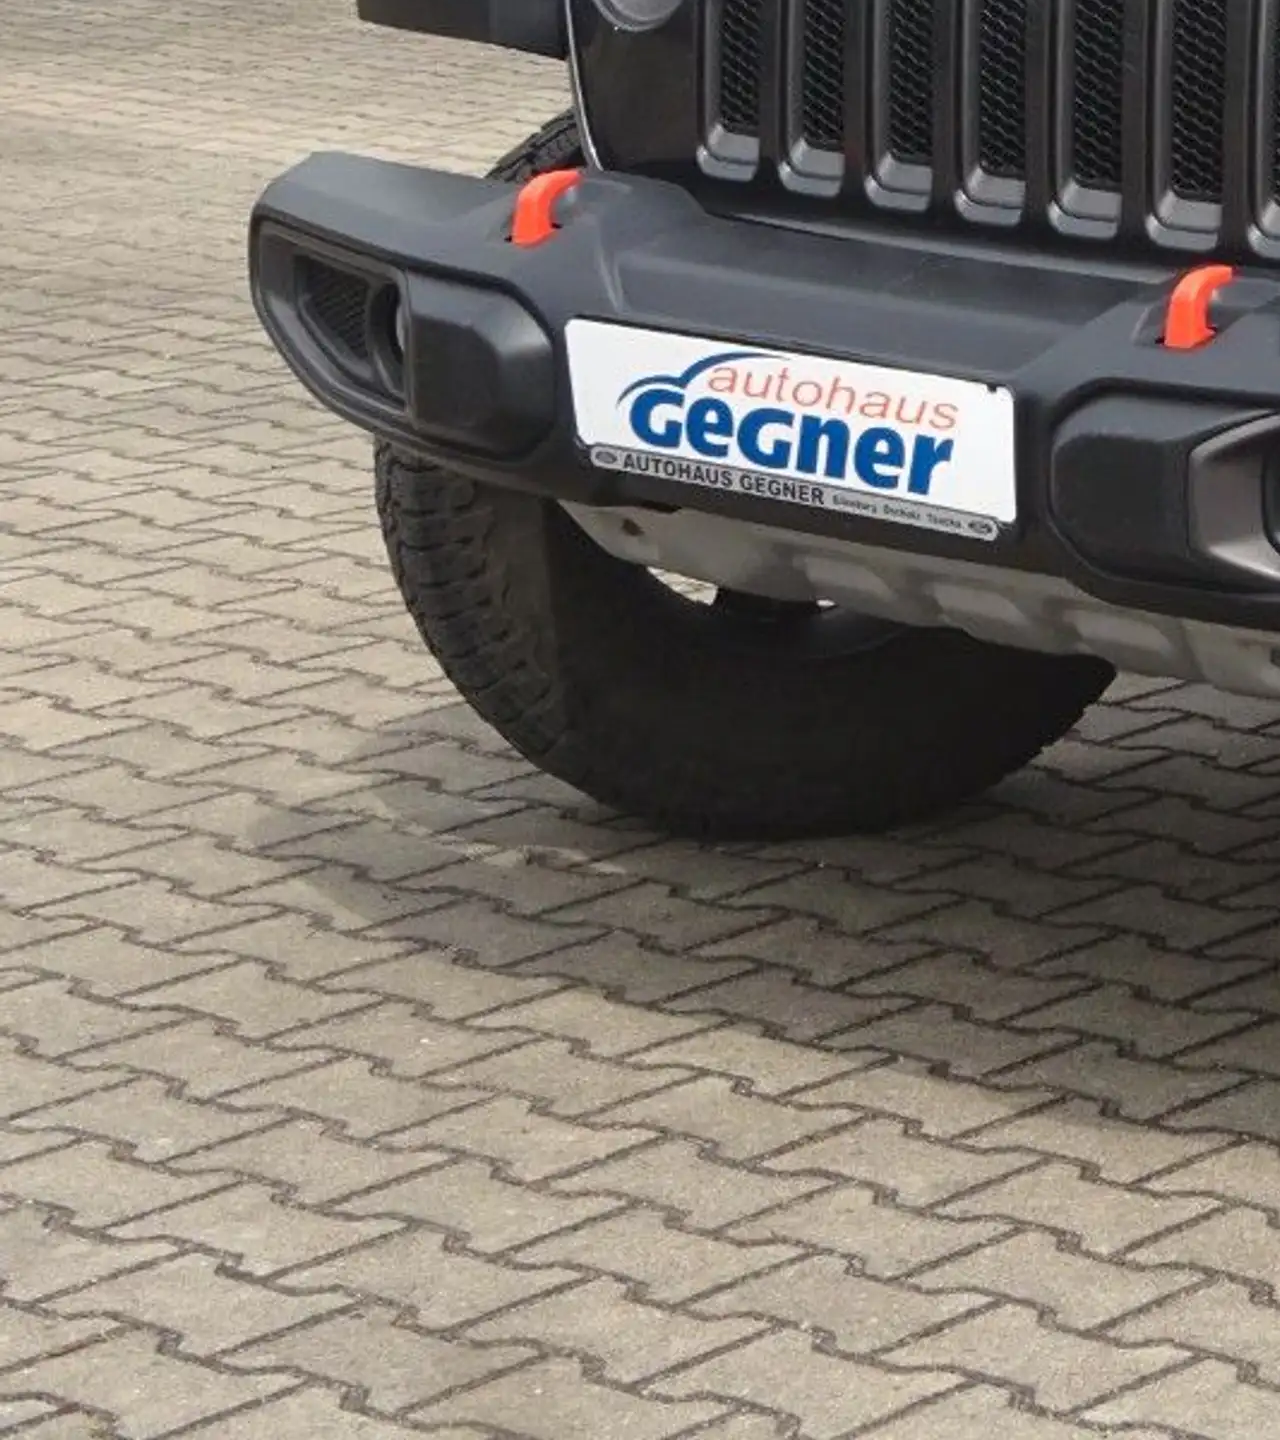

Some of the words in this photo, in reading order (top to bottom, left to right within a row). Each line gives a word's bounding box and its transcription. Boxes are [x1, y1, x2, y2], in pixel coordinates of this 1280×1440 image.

[707, 366, 959, 430] autohaus
[622, 452, 733, 488] AUTOHAUS
[739, 474, 825, 506] GEGNER
